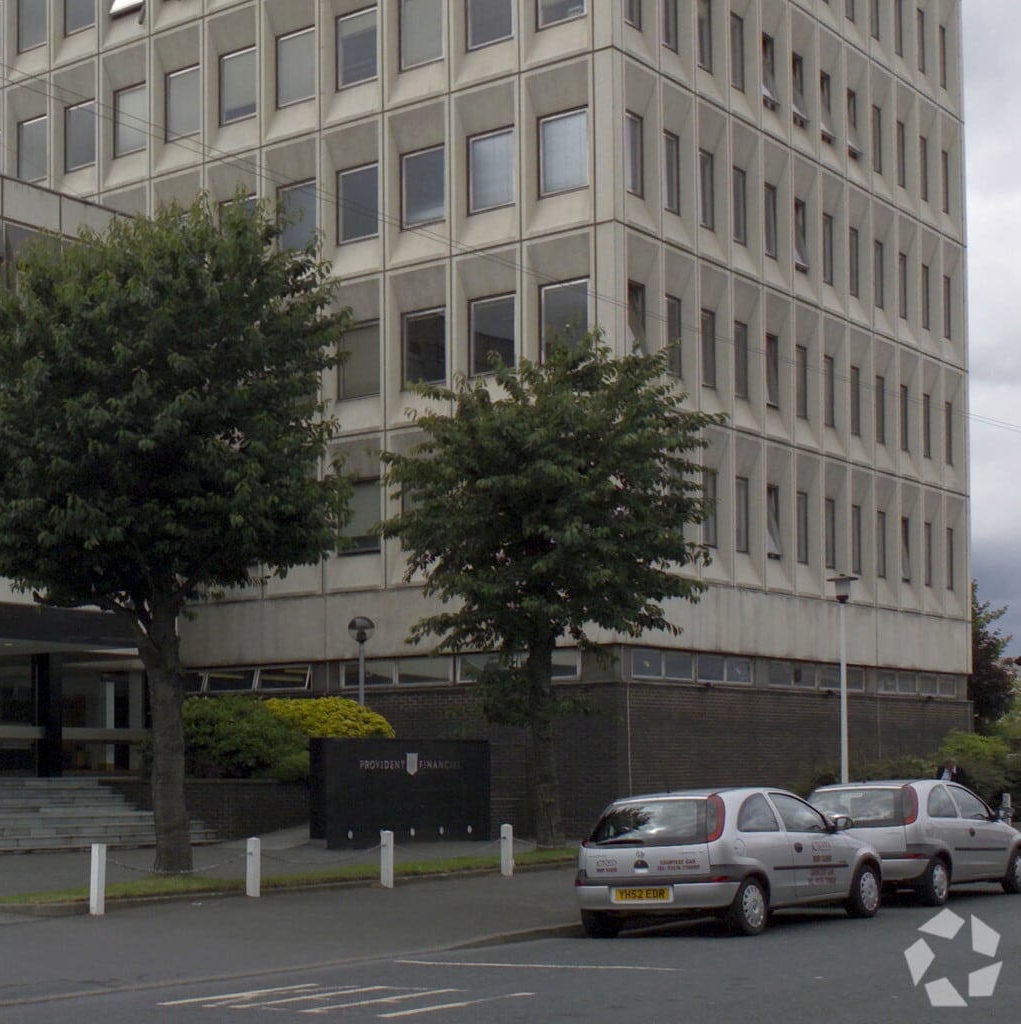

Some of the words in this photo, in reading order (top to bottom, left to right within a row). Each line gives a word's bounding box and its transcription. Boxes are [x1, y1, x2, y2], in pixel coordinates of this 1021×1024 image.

[358, 759, 405, 769] PROVIDENT
[419, 759, 463, 769] FINANCIAL
[618, 888, 643, 899] YH52
